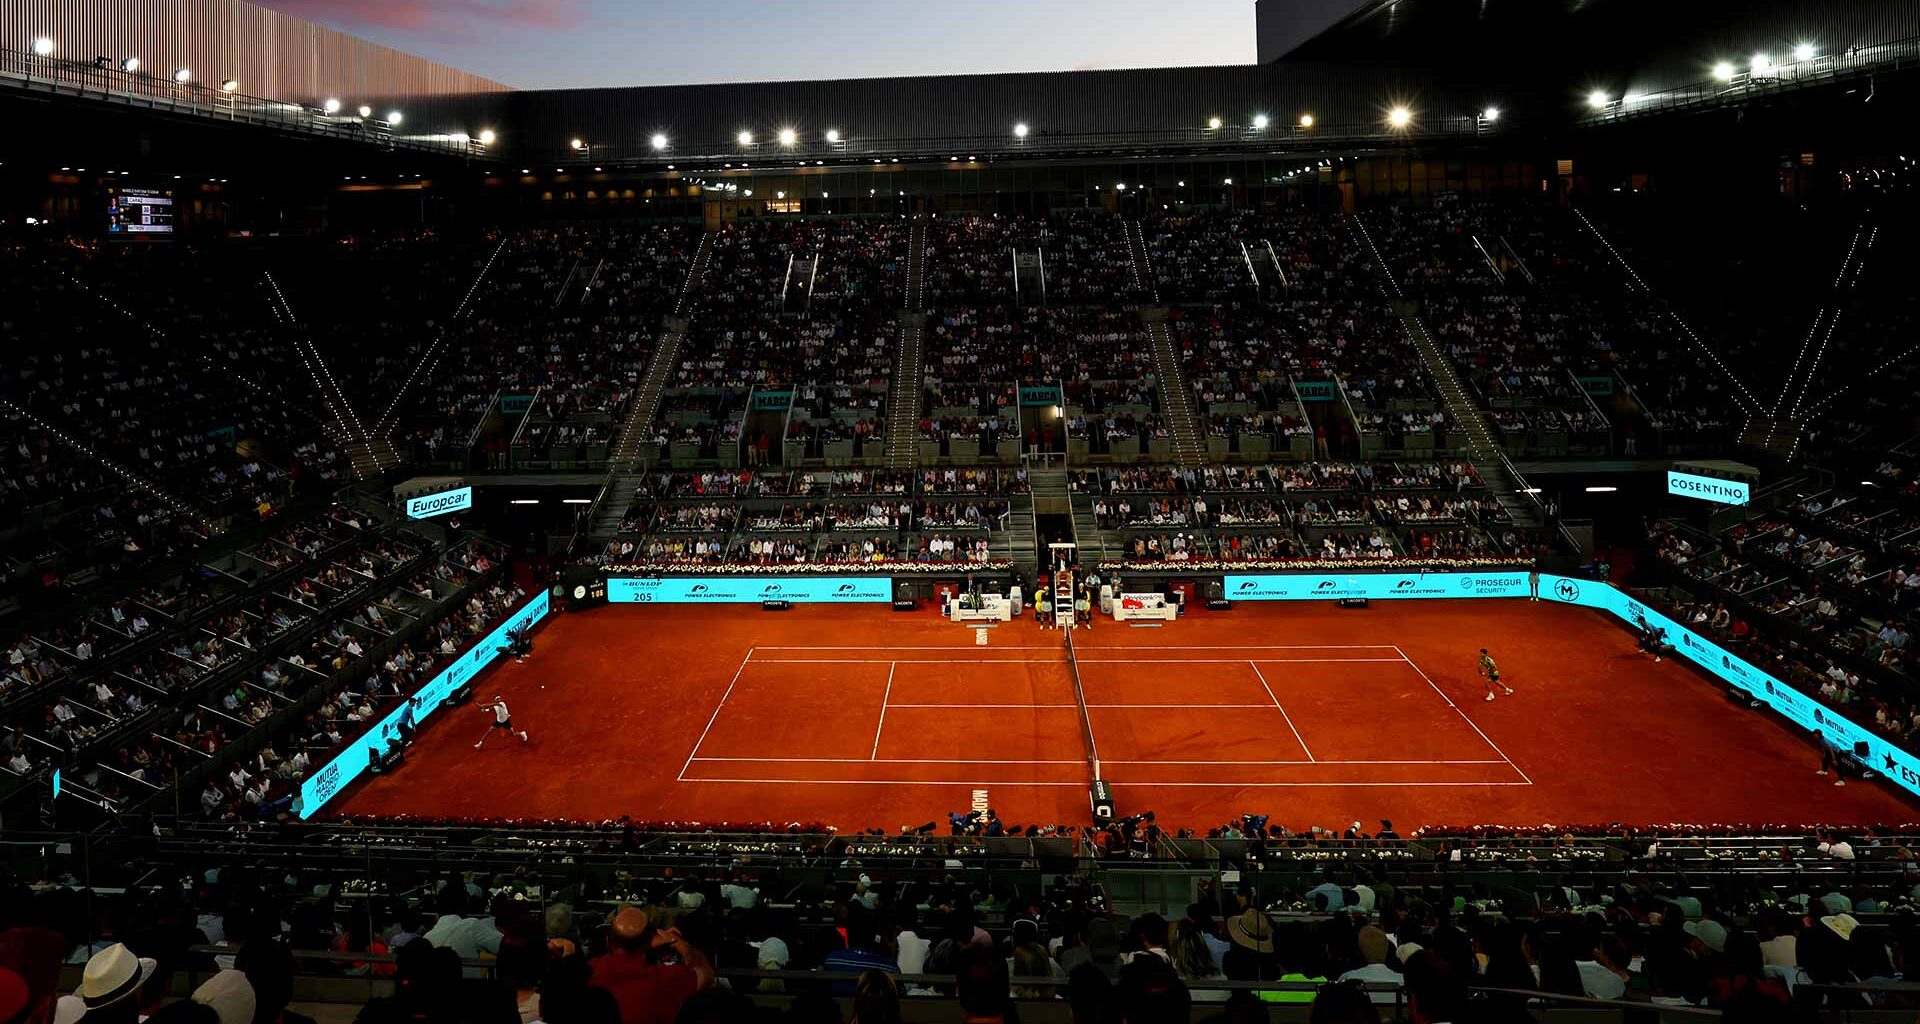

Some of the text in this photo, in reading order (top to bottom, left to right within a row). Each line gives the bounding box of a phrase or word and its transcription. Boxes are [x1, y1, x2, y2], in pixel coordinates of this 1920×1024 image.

[758, 396, 791, 406] MARCA
[1023, 391, 1057, 402] MARCA
[1671, 478, 1743, 499] COSENTINO
[412, 493, 468, 513] Europcar
[1475, 578, 1522, 587] PROSEGUR
[634, 593, 652, 602] 205
[315, 773, 340, 796] MADRID
[316, 763, 339, 787] MUTUA
[319, 784, 337, 803] OPEN
